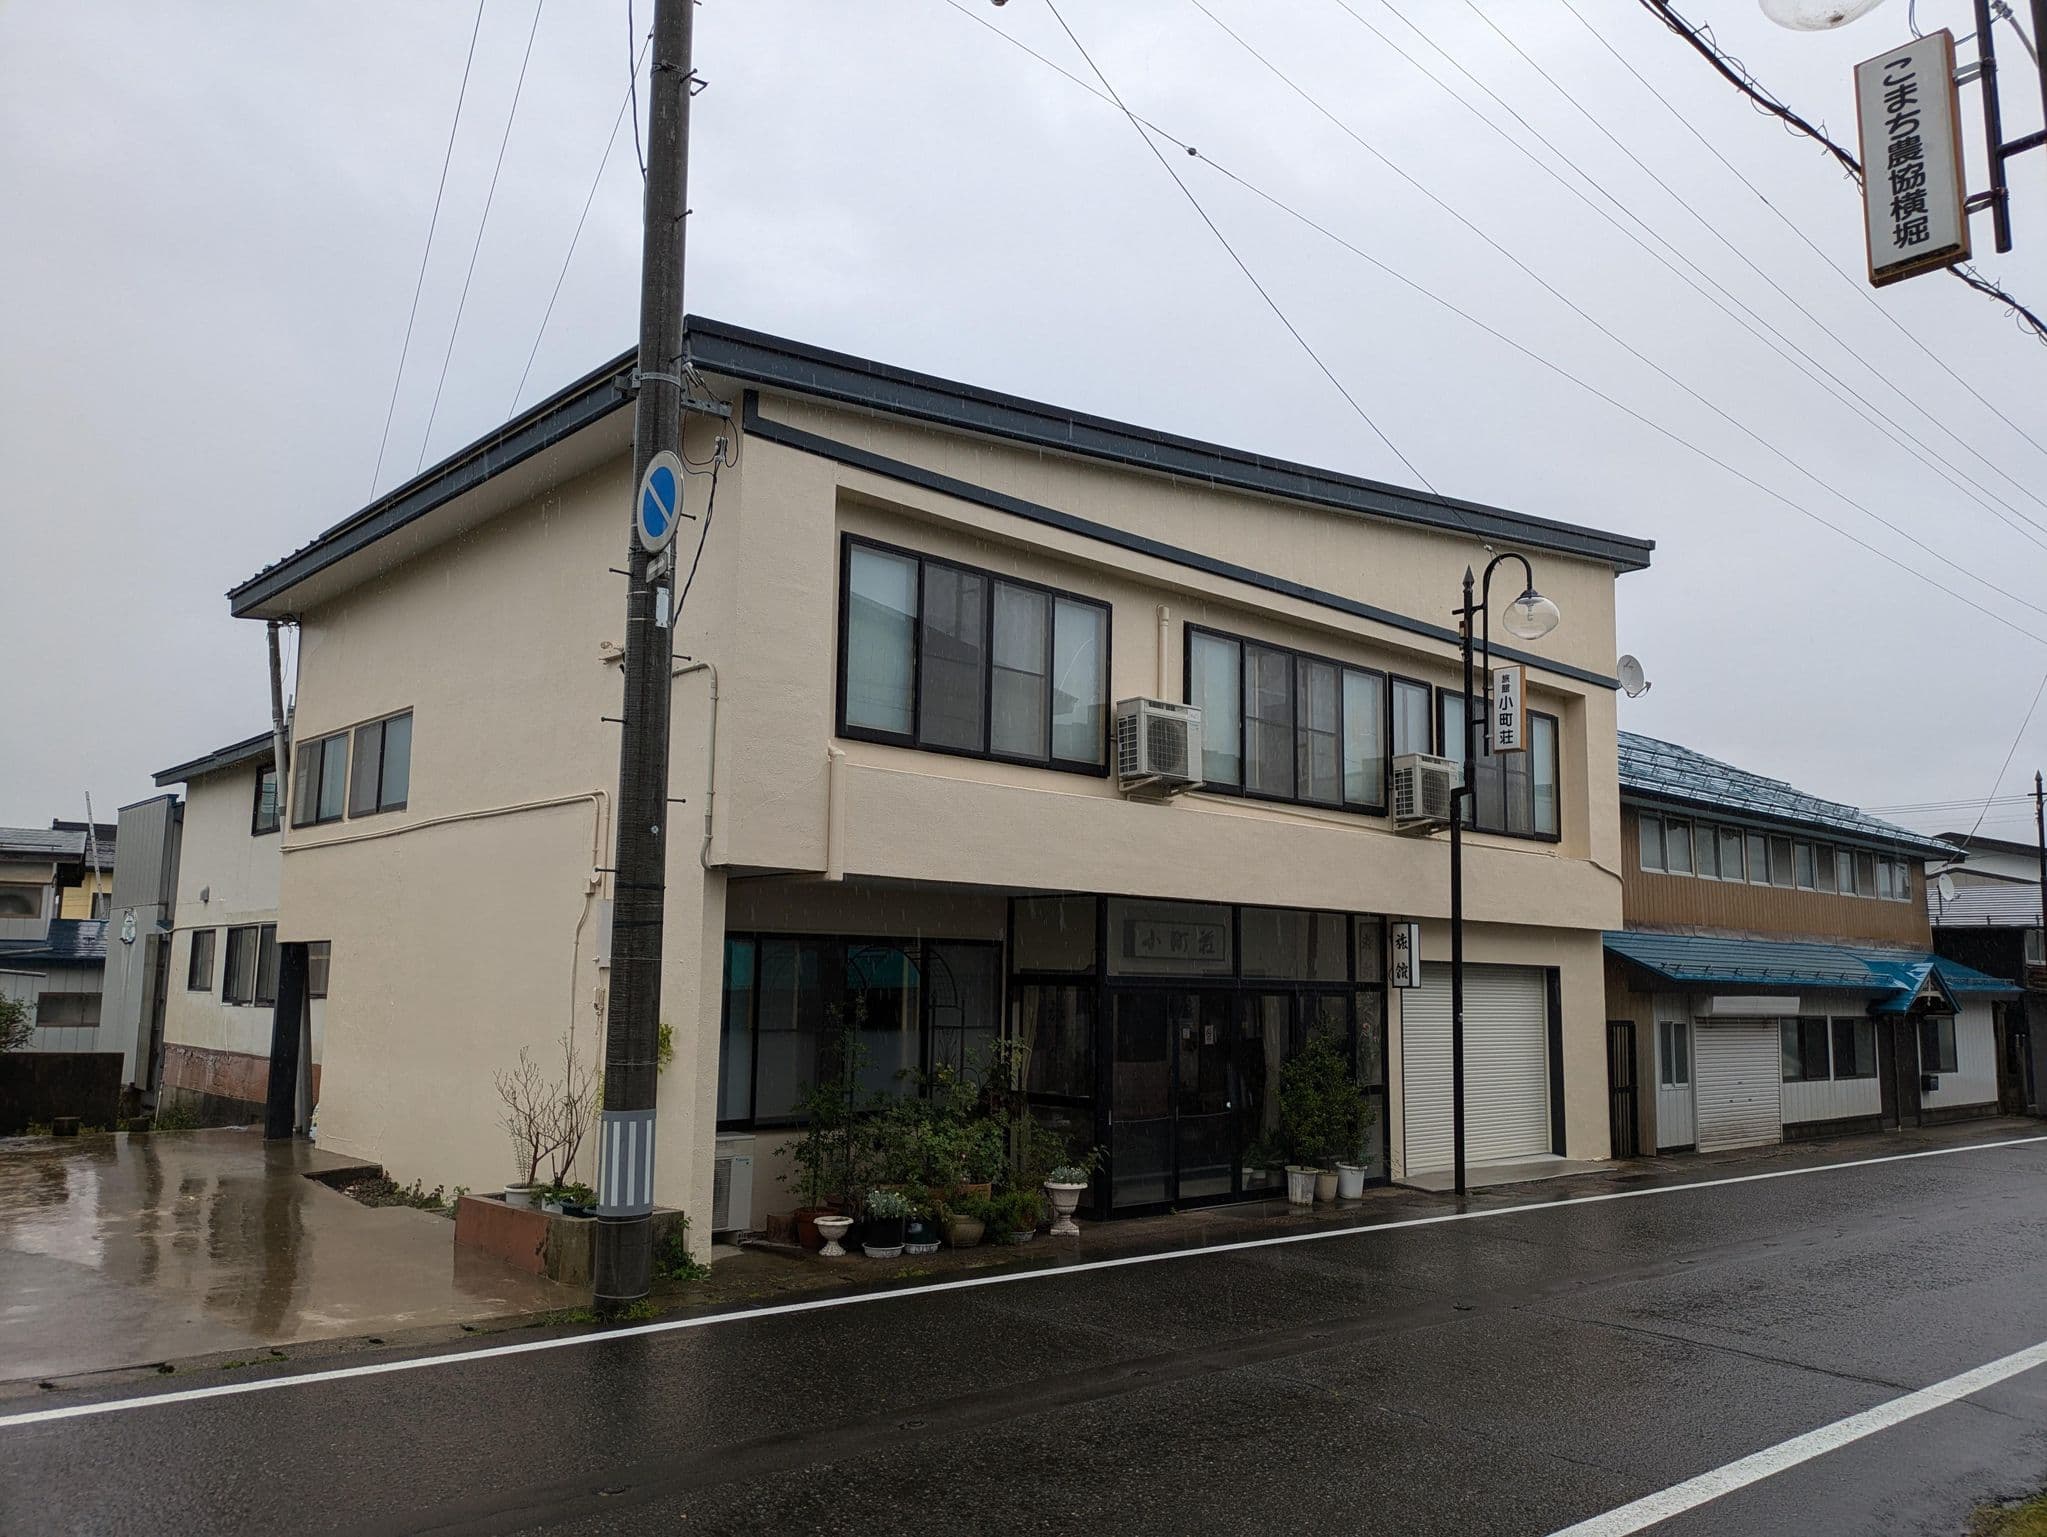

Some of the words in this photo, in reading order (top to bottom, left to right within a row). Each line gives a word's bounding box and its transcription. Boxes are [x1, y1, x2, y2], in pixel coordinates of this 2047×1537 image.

[1883, 56, 1930, 249] こまち農協横堀
[1499, 695, 1513, 745] 小町荘
